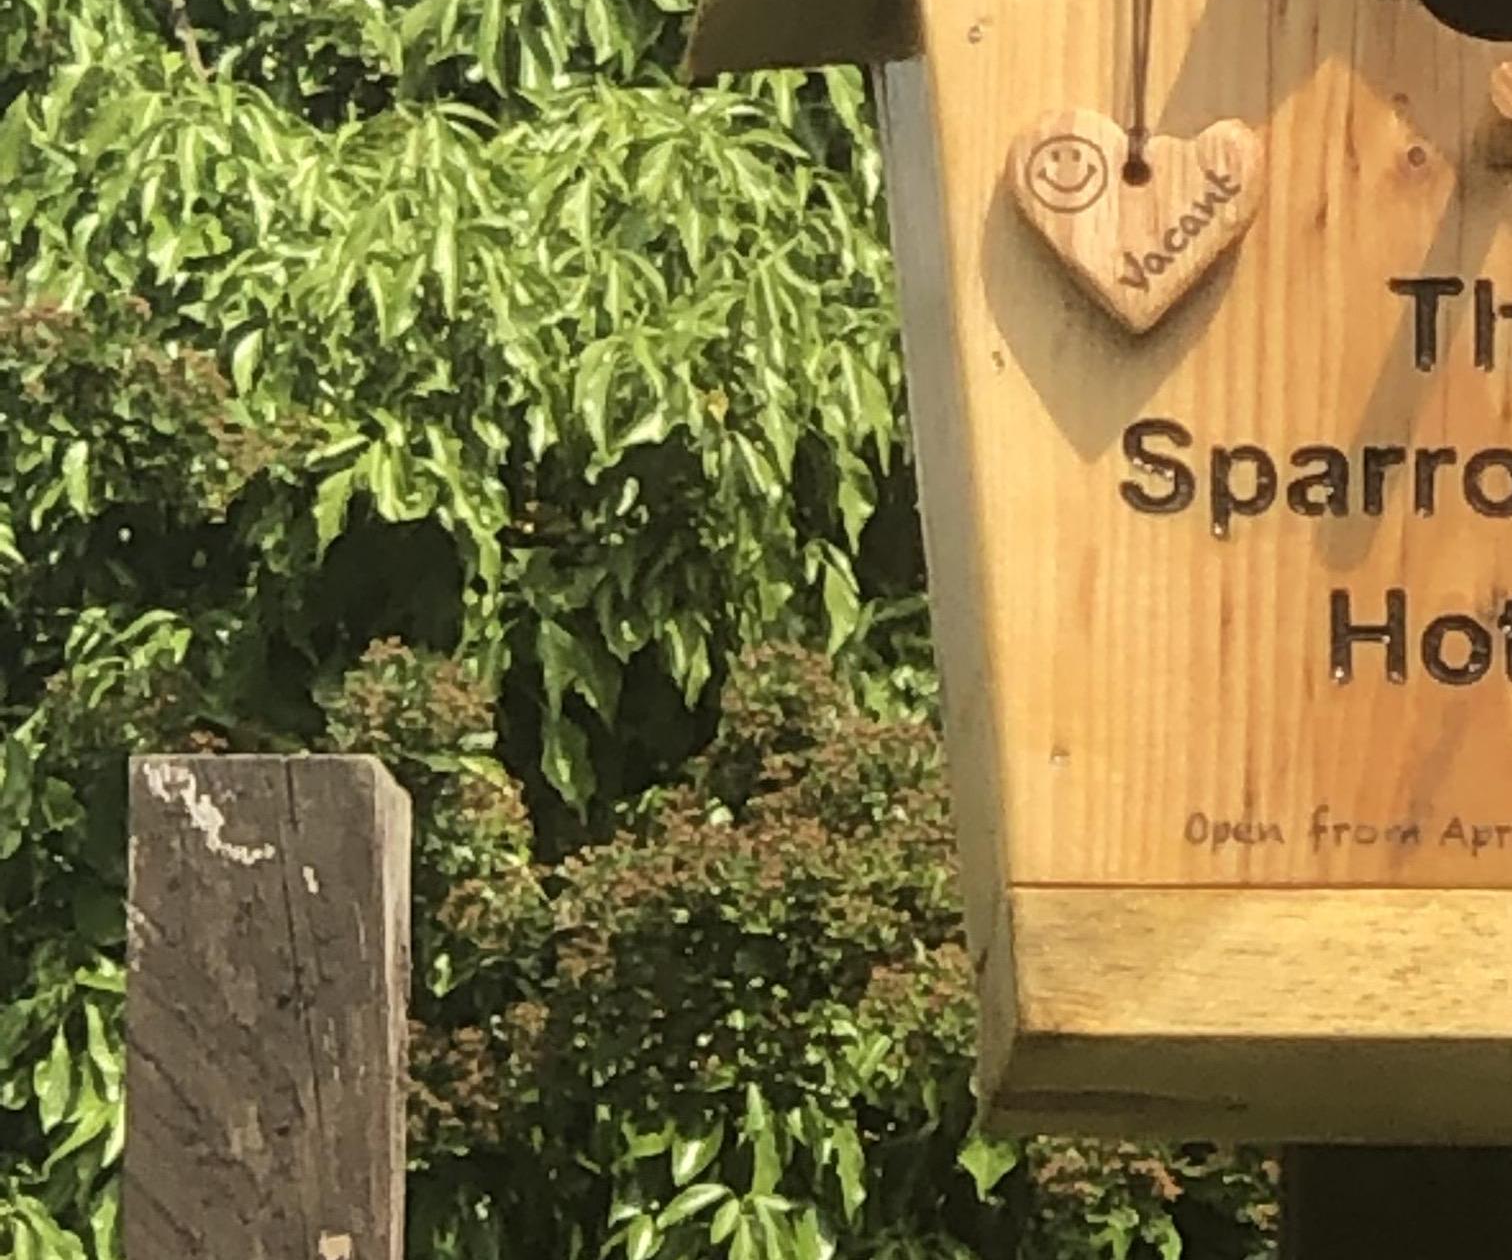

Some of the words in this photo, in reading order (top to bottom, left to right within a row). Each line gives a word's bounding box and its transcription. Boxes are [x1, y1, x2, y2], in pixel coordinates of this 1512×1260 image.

[1117, 169, 1241, 292] Vacant
[1185, 812, 1285, 855] Open
[1308, 805, 1420, 852] from
